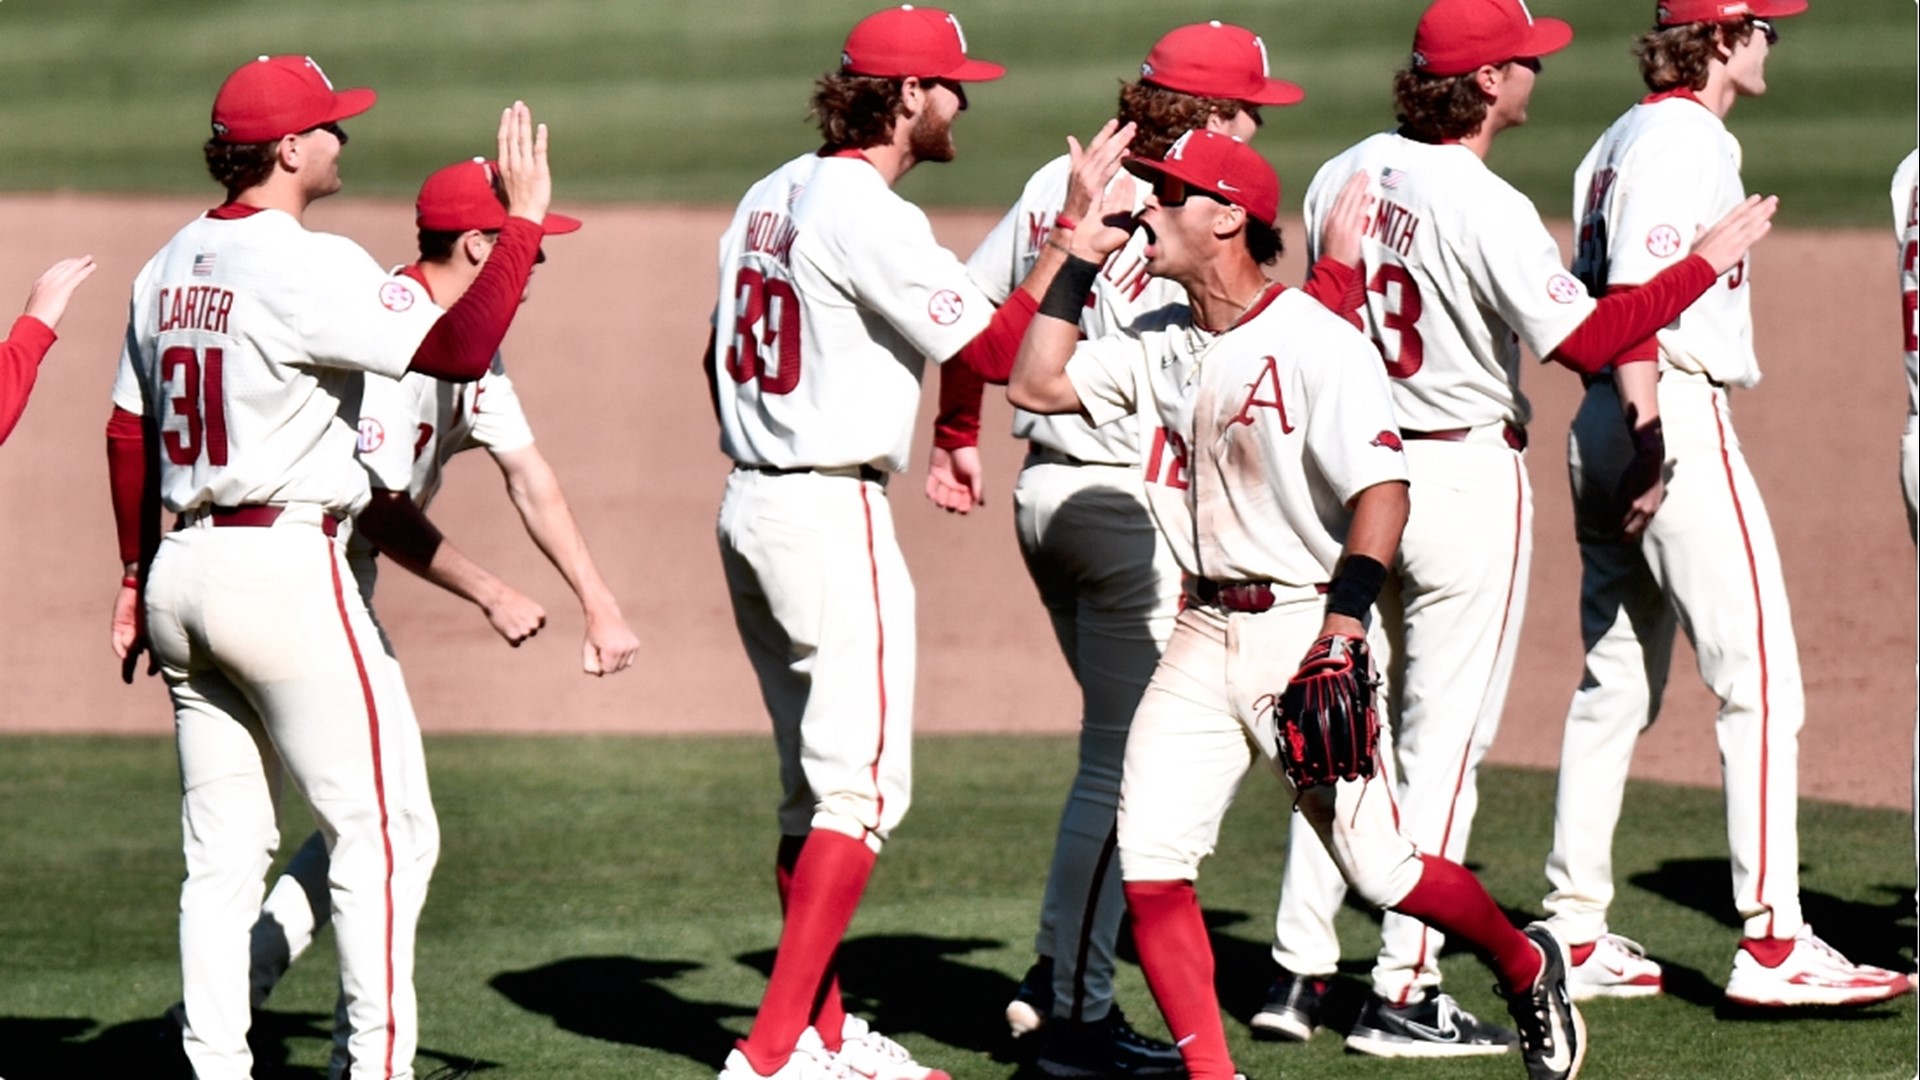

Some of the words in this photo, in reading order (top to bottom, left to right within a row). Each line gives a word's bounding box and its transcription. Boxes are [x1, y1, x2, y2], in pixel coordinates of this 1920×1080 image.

[158, 285, 234, 334] CARTER
[725, 267, 801, 395] 39
[161, 345, 228, 467] 31
[1223, 354, 1296, 435] A
[1144, 425, 1190, 491] 12
